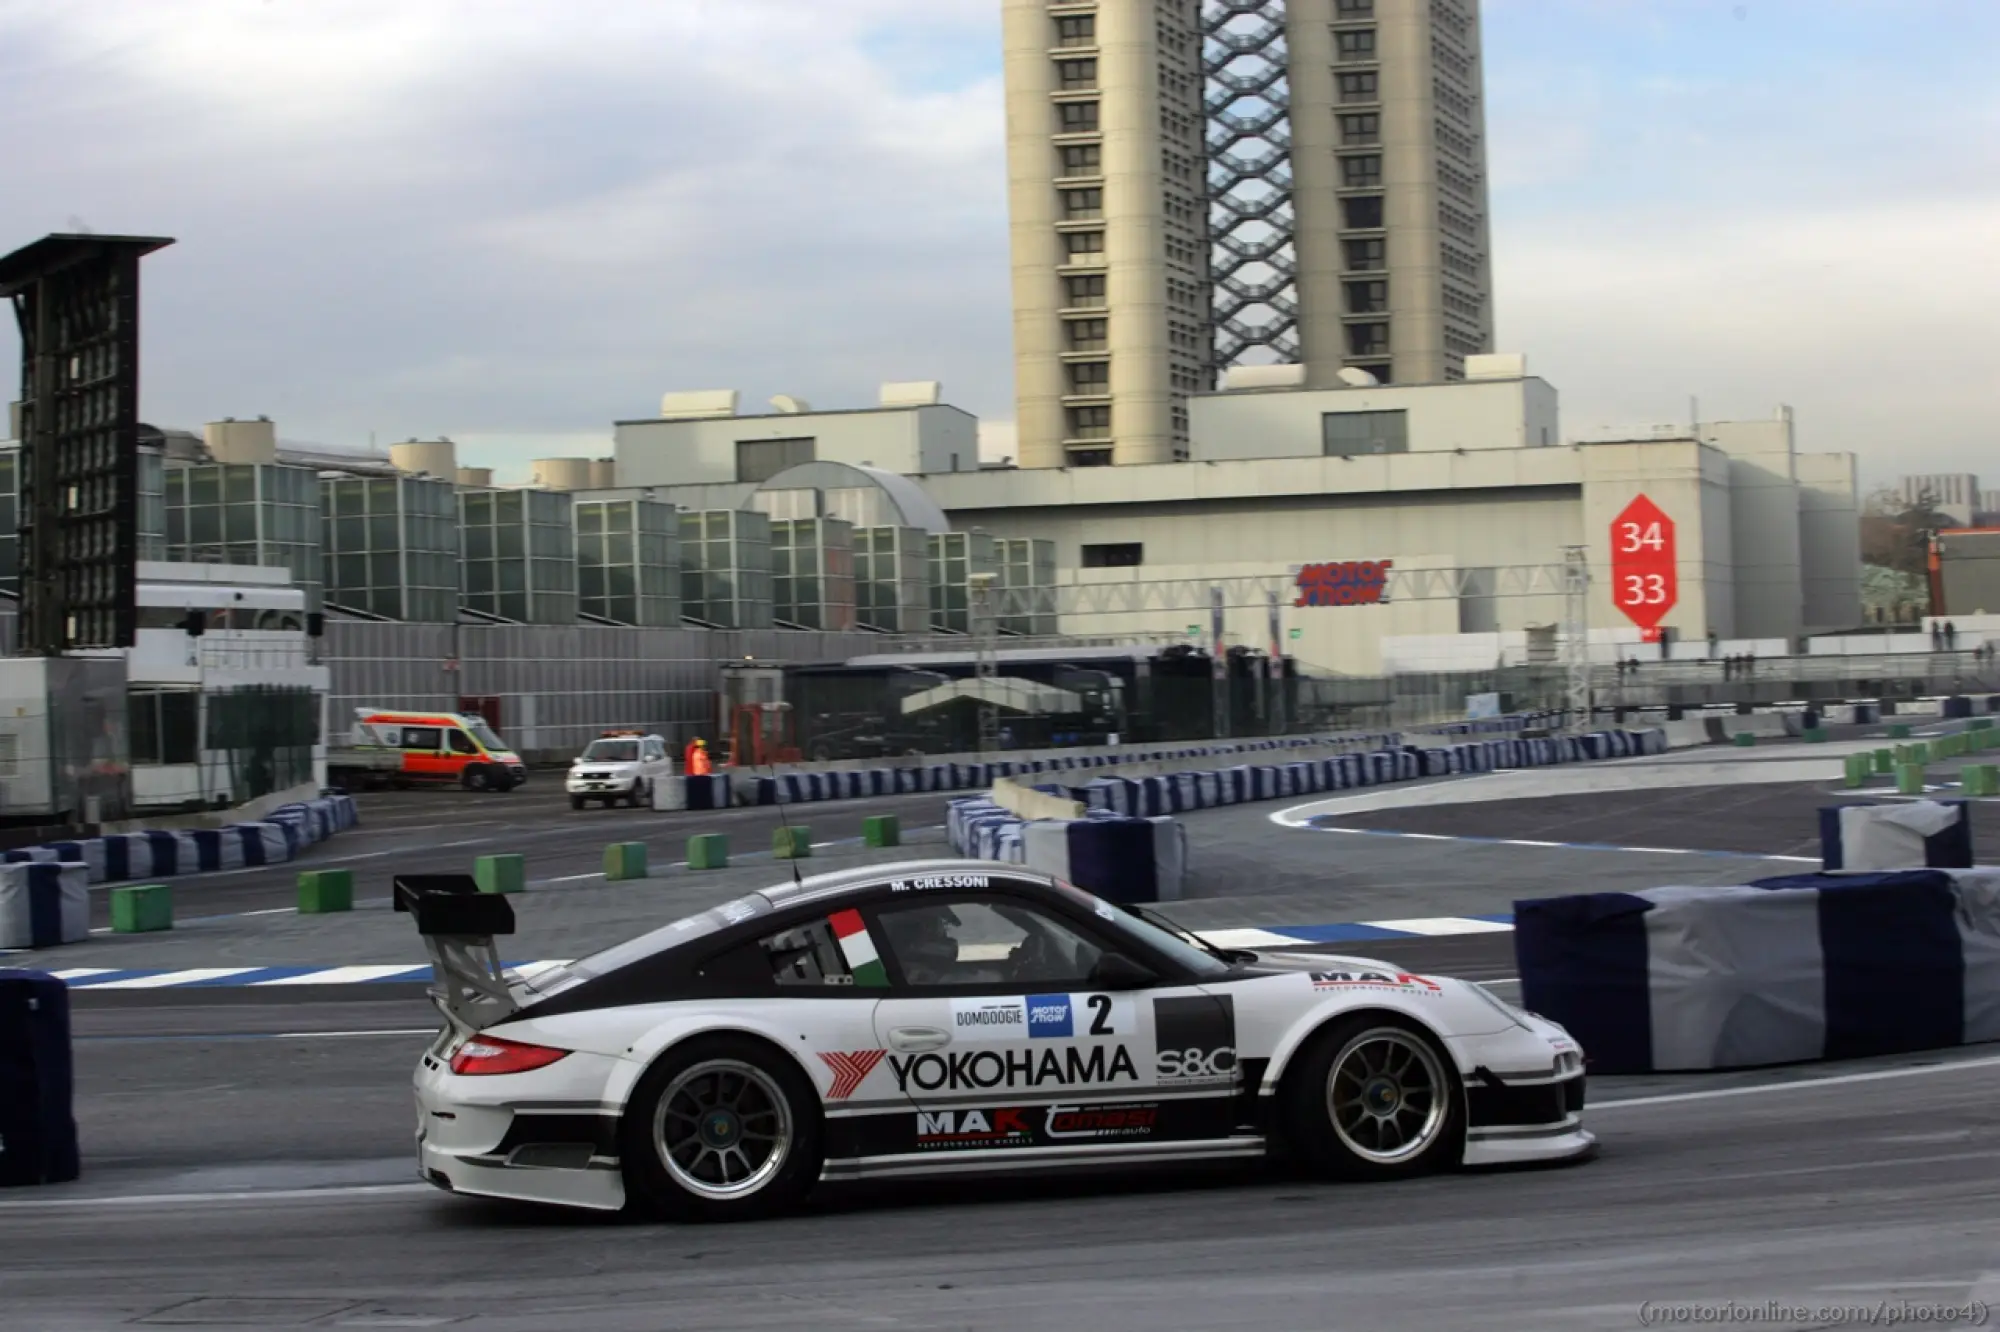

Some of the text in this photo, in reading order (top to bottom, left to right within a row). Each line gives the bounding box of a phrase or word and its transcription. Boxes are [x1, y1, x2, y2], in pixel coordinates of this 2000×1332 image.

[1620, 522, 1665, 552] 34
[1623, 574, 1666, 605] 33
[891, 876, 989, 892] M. CRESSONI
[1087, 994, 1114, 1036] 2
[888, 1044, 1139, 1092] YOKOHAMA
[1156, 1046, 1236, 1077] S&C
[916, 1107, 1030, 1135] MAK
